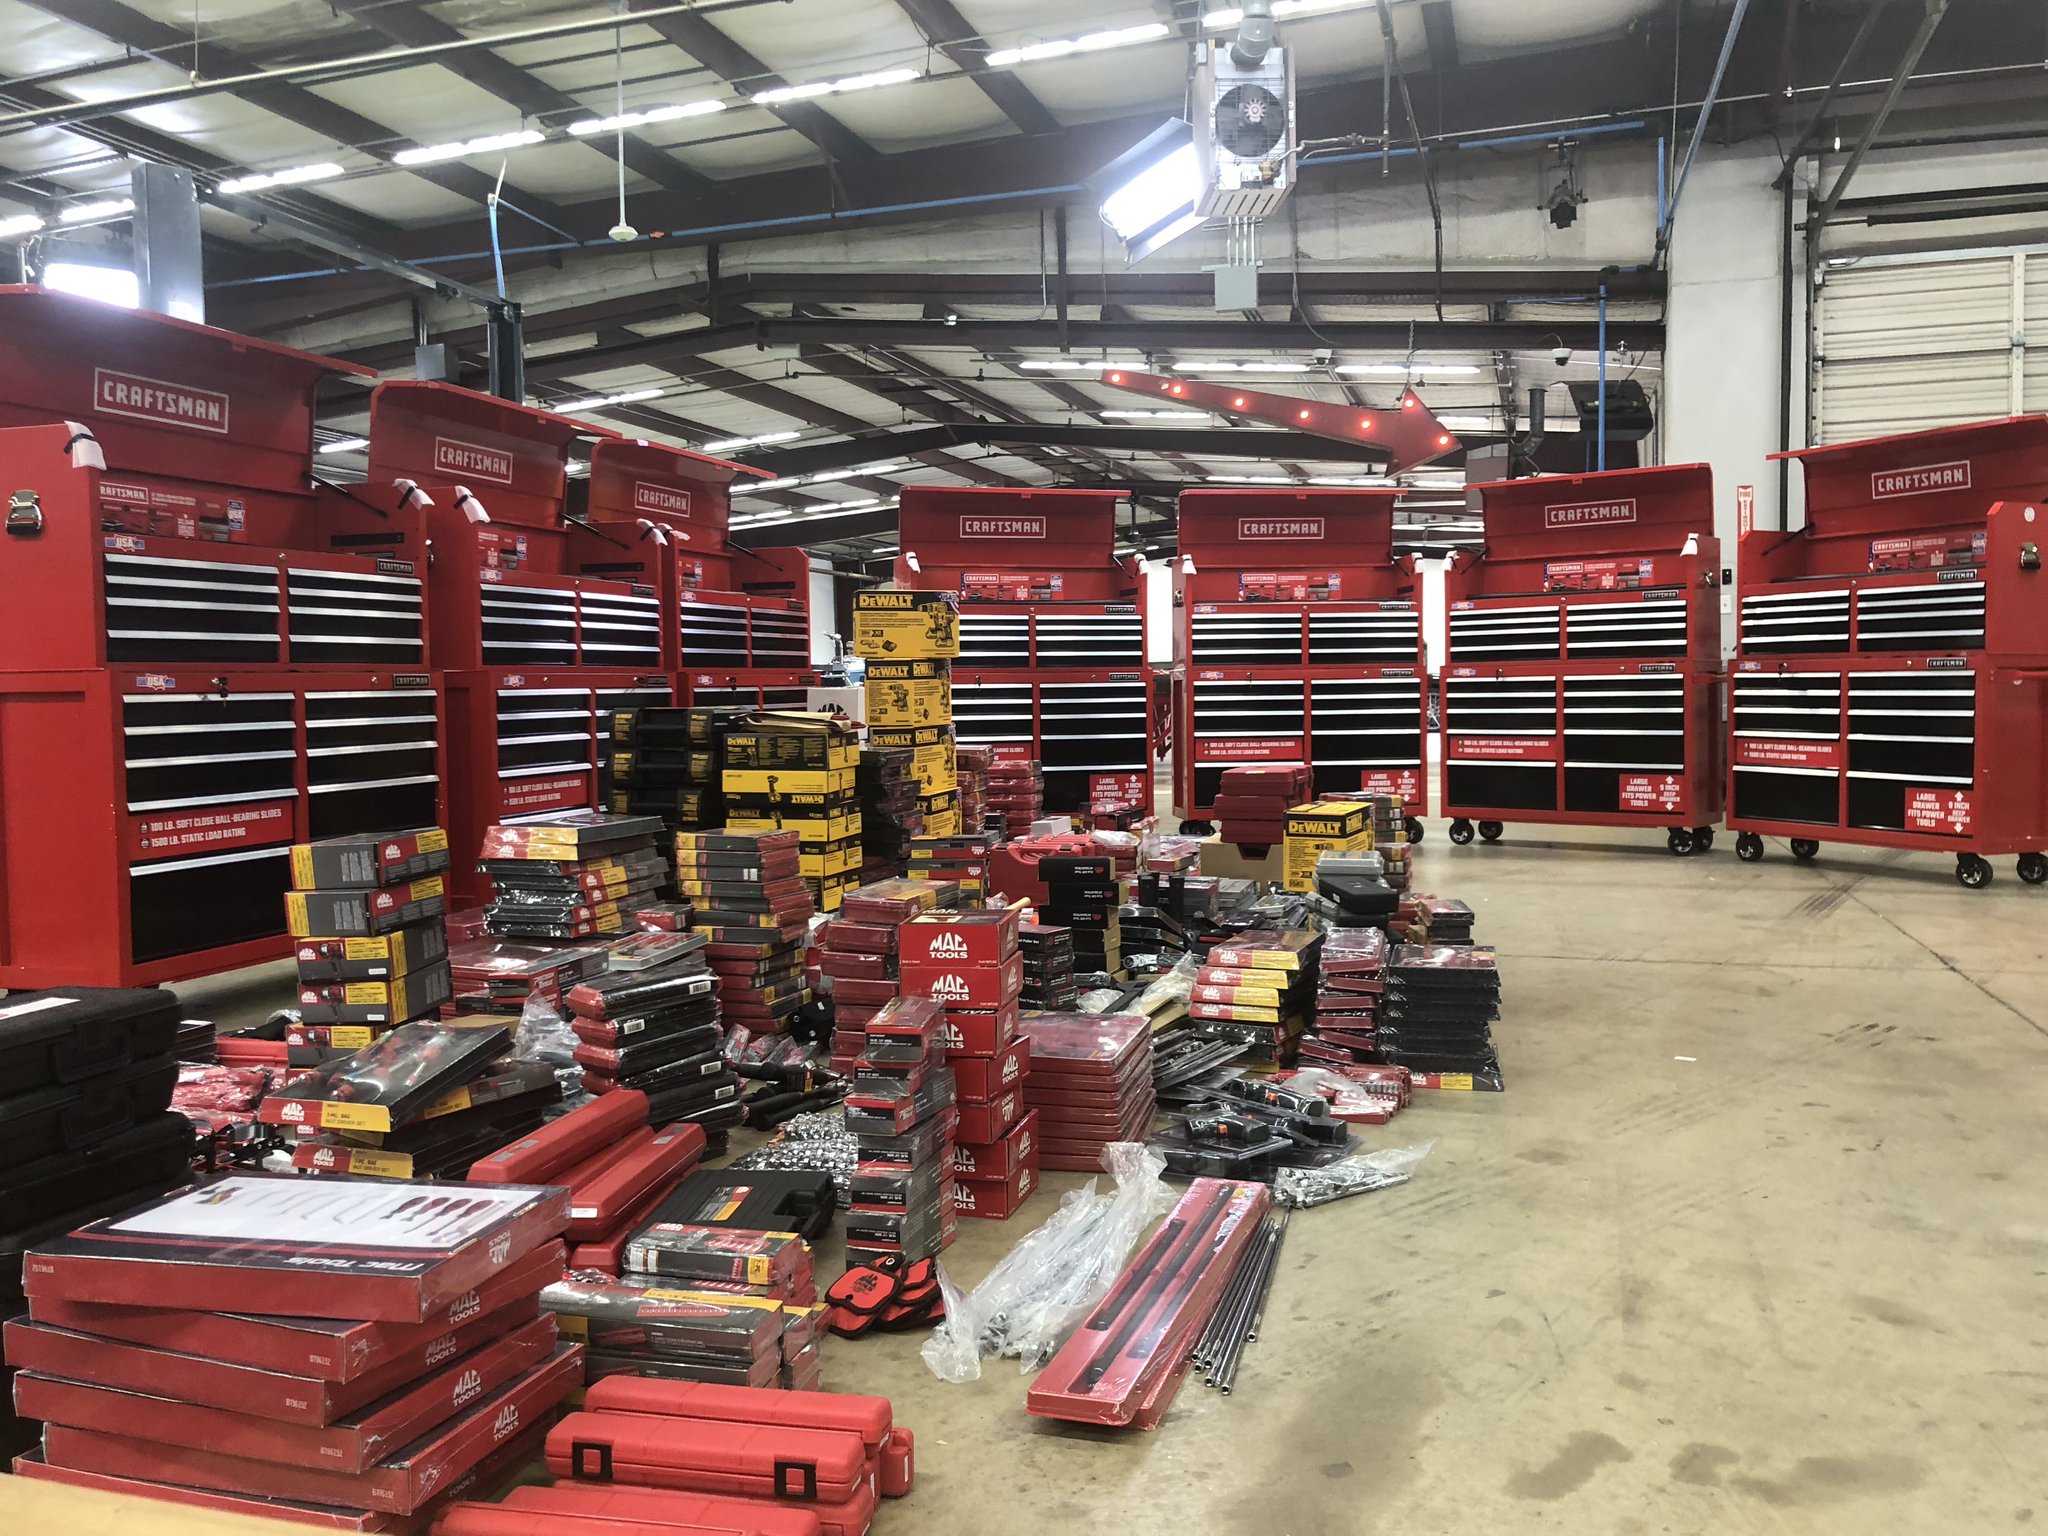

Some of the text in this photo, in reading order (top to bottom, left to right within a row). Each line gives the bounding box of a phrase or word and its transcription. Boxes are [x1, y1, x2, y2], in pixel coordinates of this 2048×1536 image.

[103, 382, 220, 422] CRAFTSMAN
[439, 445, 508, 475] CRAFTSMAN
[1877, 468, 1963, 492] CRAFTSMAN
[100, 485, 145, 500] RAFTSMAN
[638, 489, 687, 510] CRAFTSMAN
[1550, 505, 1630, 522] CRAFTSMAN
[965, 521, 1040, 533] CRAFTSMAN
[1243, 523, 1318, 535] CRAFTSMAN
[116, 537, 133, 548] USA
[1874, 542, 1908, 551] CRAFTSMAN
[379, 561, 413, 574] CRAFTSMAN
[965, 574, 999, 582] CRAFTSMAN
[1940, 571, 1974, 580] CRAFTSMAN
[859, 594, 913, 609] DEWALT
[868, 666, 909, 677] DEWALT
[146, 676, 165, 688] USA
[395, 676, 429, 686] CRAFTSMAN
[727, 737, 756, 746] DEWALT
[873, 734, 912, 745] DEWALT
[1630, 799, 1649, 807] TOOLS
[1635, 792, 1657, 800] POWER
[1916, 793, 1936, 802] LARGE
[1912, 801, 1940, 810] DRAWER
[1953, 801, 1970, 810] INCH
[150, 808, 282, 832] 100 LB. SOFT CLOSE BALL-BEARING SLIDES
[1907, 808, 1945, 820] FITS POWER
[1288, 821, 1341, 834] DEWALT
[1916, 818, 1936, 827] TOOLS
[151, 827, 246, 848] 1500 LB. STATIC LOAD RATING
[929, 932, 968, 951] MAC
[929, 951, 968, 959] TOOLS
[931, 974, 970, 993] MAC
[931, 993, 970, 1001] TOOLS
[936, 1021, 964, 1041] AC
[1002, 1054, 1019, 1077] MAC
[1002, 1070, 1019, 1085] TOOLS
[281, 1102, 305, 1116] MAC
[1019, 1130, 1031, 1155] MAC
[313, 1148, 335, 1161] MAC
[952, 1145, 975, 1165] AC
[312, 1159, 334, 1167] TOOLS
[954, 1164, 976, 1173] OLS
[1018, 1168, 1031, 1193] MAC
[952, 1182, 976, 1203] AC
[954, 1201, 976, 1210] OLS
[449, 1290, 480, 1316] MAC
[449, 1306, 481, 1325] TOOLS
[426, 1335, 457, 1358] MAC
[425, 1346, 457, 1366] TOOLS
[452, 1368, 482, 1398] MAC
[452, 1385, 482, 1407] TOOLS
[493, 1403, 519, 1434] MAC
[493, 1419, 520, 1442] TOOLS
[448, 1471, 477, 1498] TOOLS
